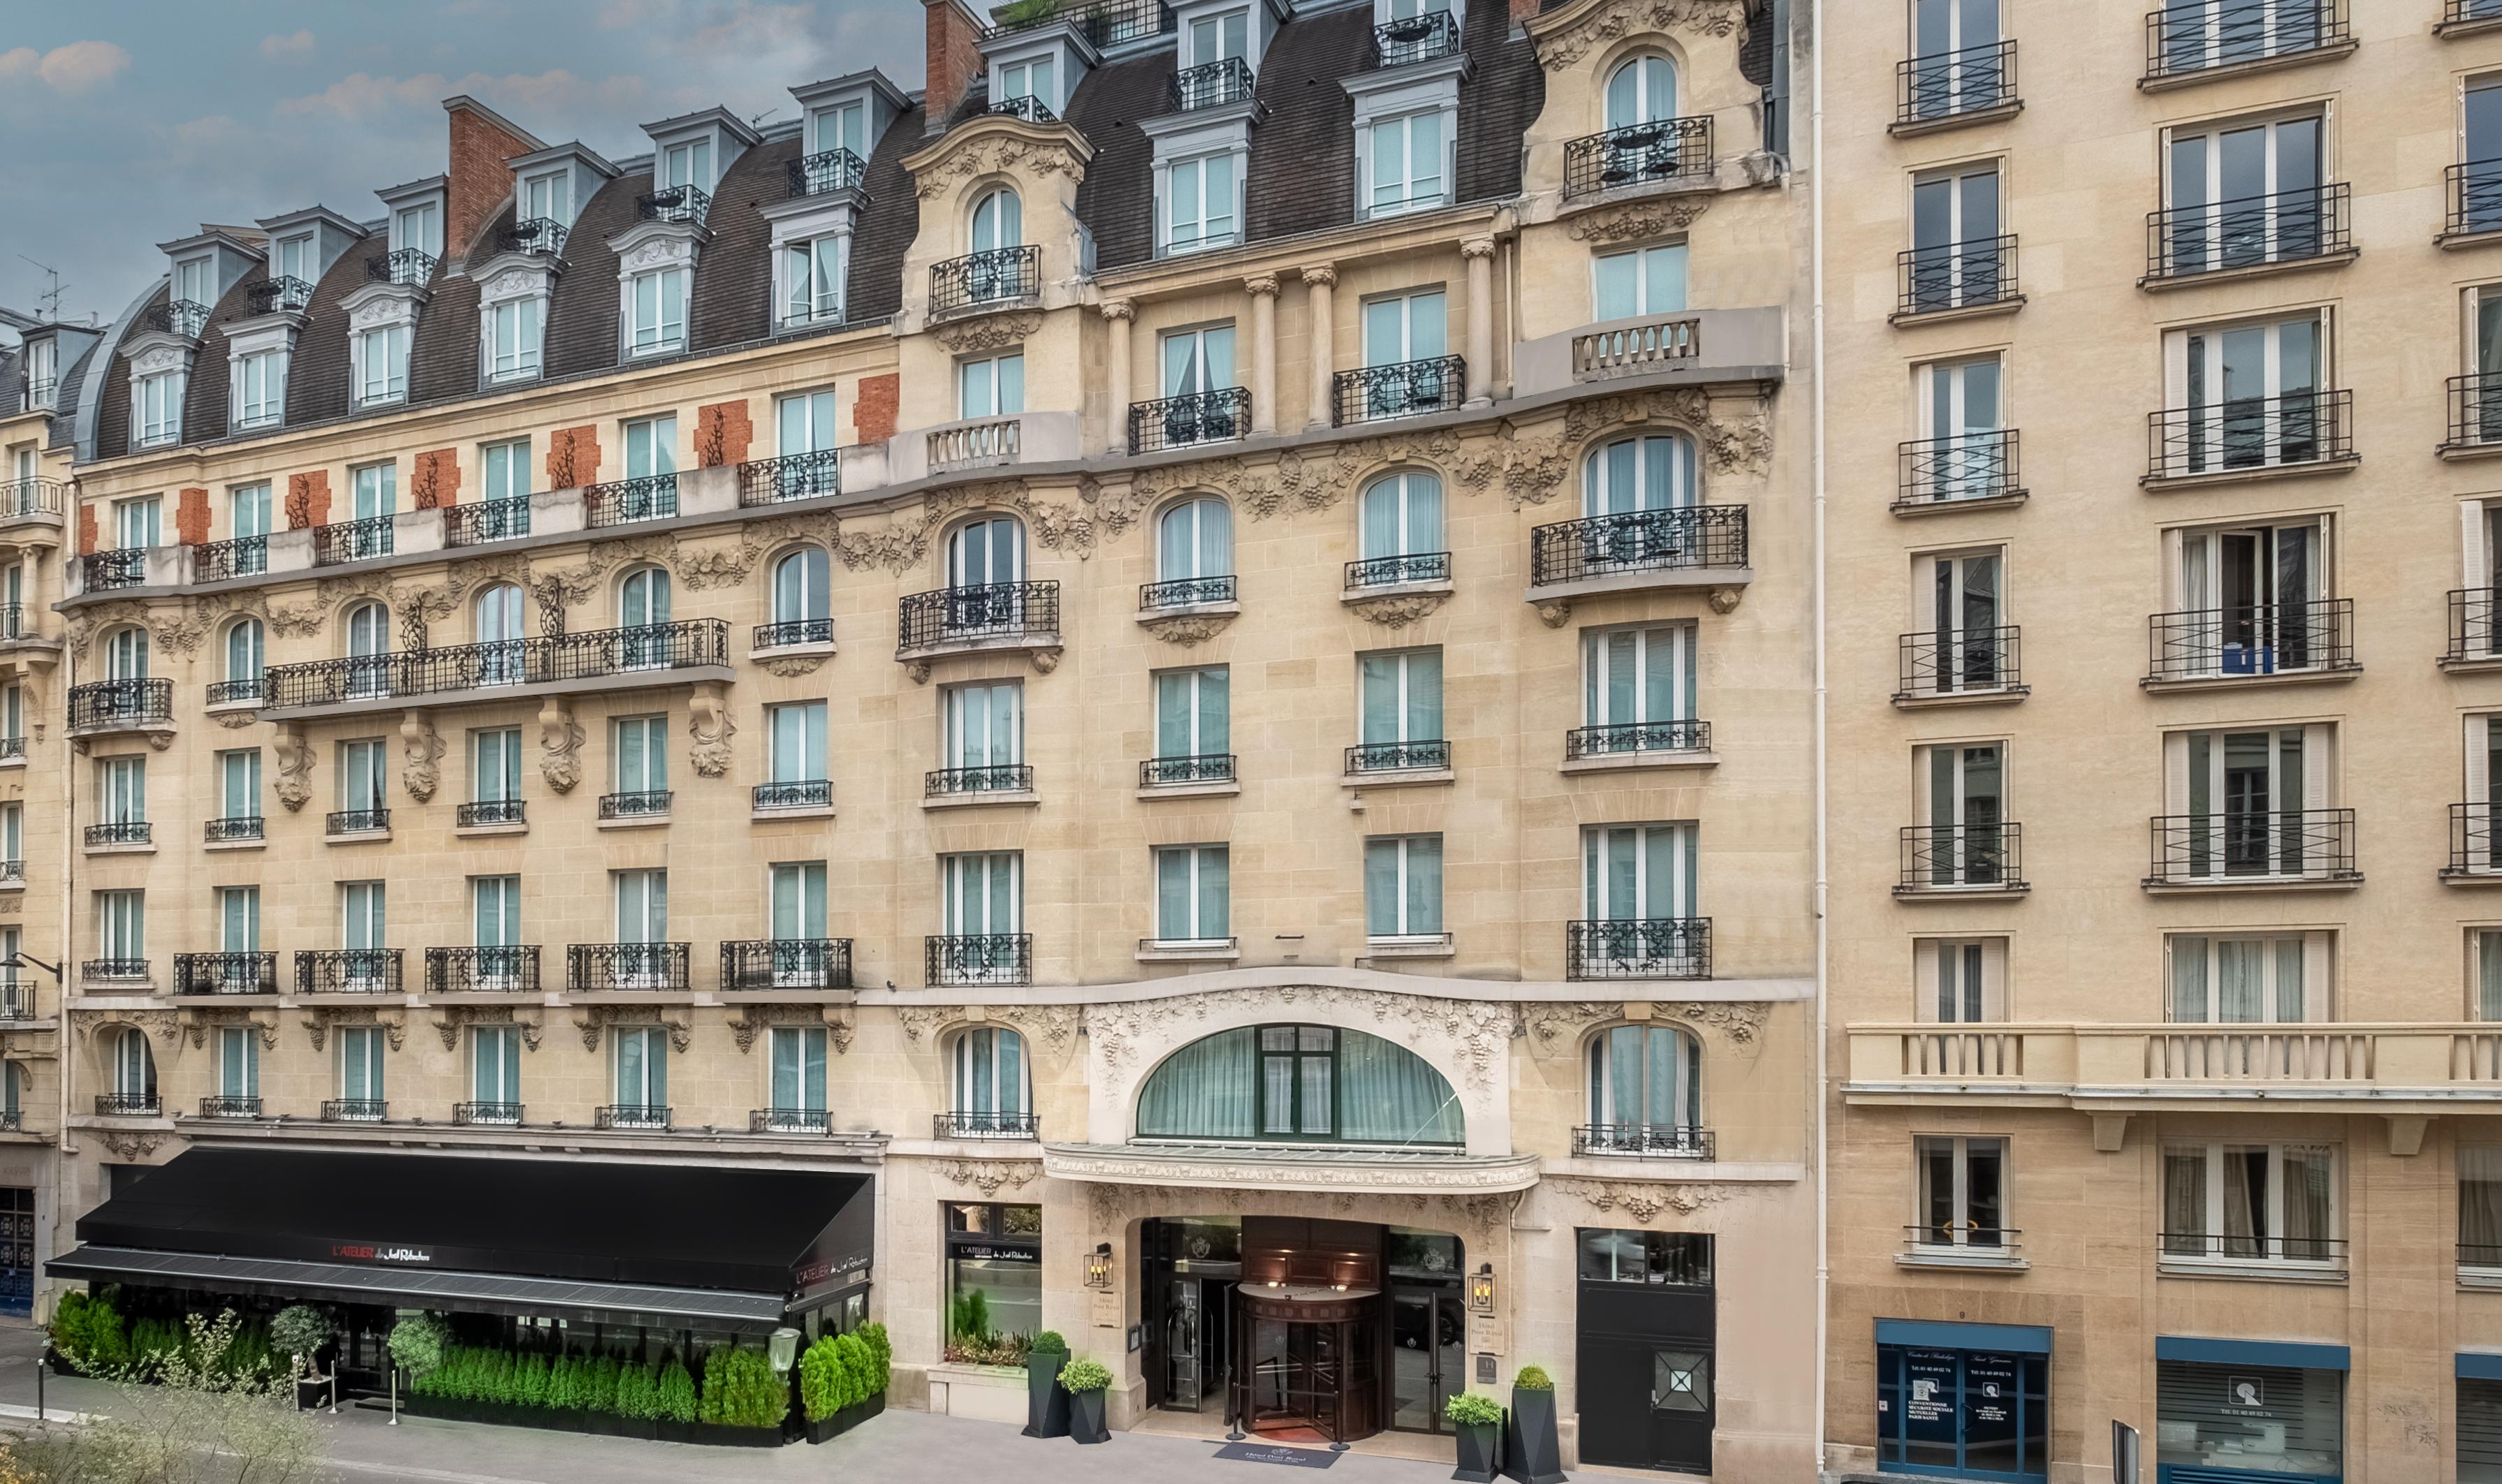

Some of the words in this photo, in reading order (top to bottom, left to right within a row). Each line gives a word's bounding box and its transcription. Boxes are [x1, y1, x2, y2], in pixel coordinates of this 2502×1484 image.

[332, 1246, 374, 1257] L'ATELIER
[961, 1246, 992, 1254] L'ATELIER
[796, 1265, 828, 1284] L'ATELIER
